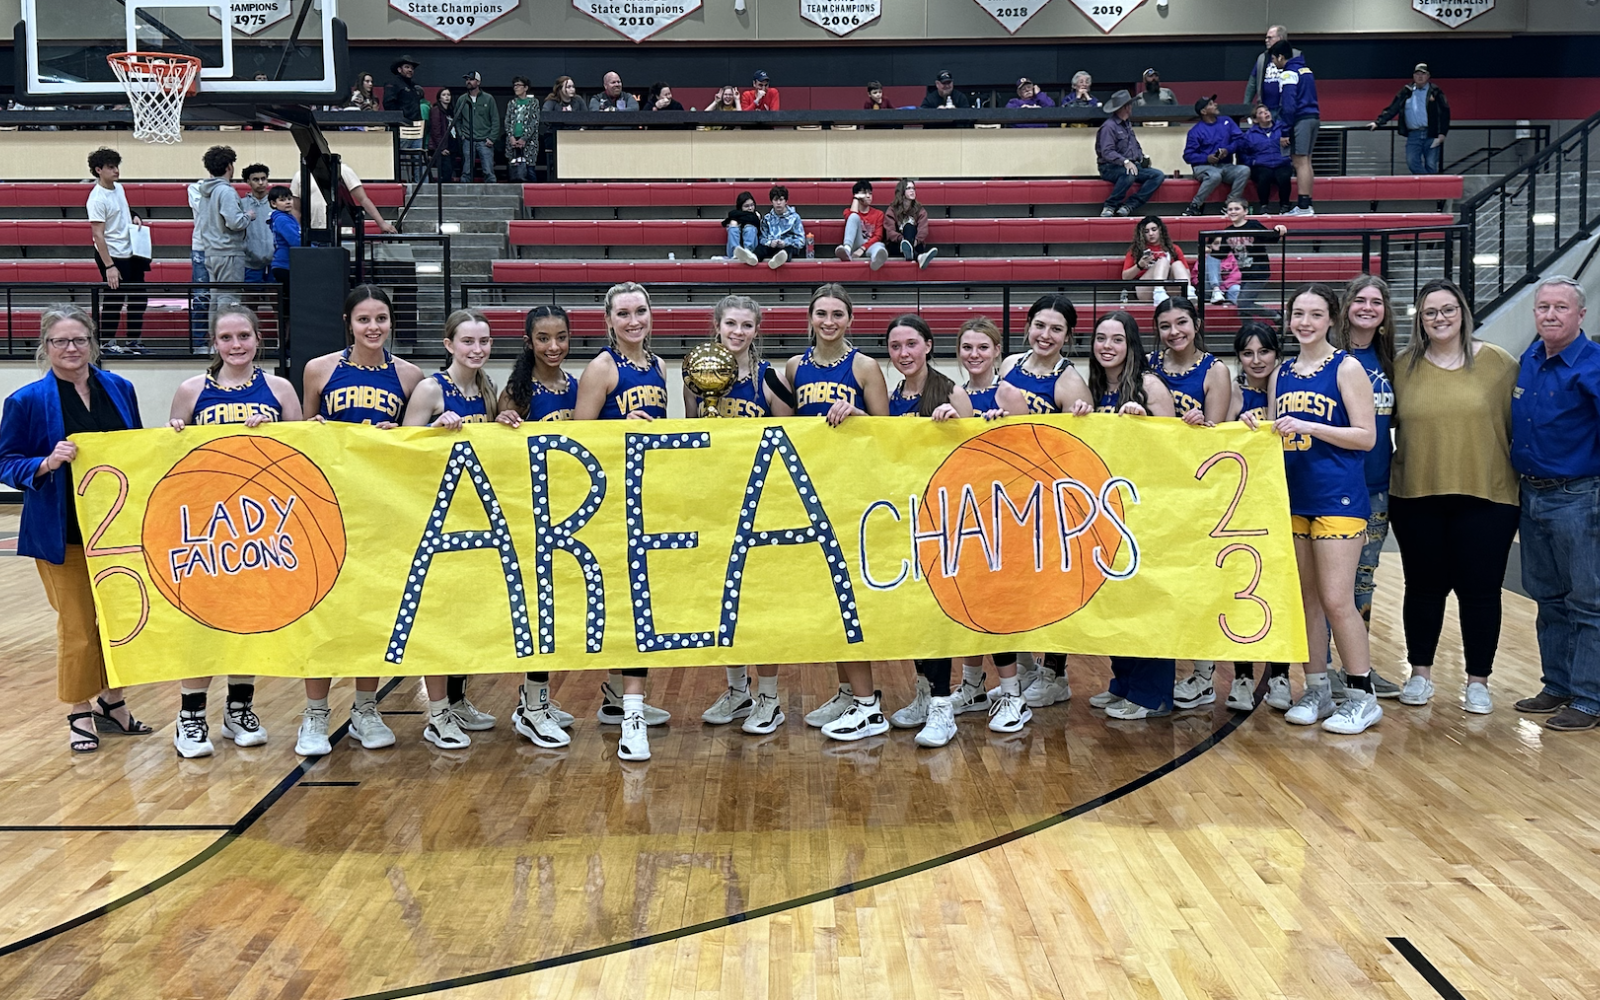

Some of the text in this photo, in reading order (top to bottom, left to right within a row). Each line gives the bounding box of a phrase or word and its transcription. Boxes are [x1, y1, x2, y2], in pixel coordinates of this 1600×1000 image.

[230, 3, 278, 12] HAMPIONS
[408, 2, 503, 15] State Champions
[590, 3, 685, 15] State Champions
[806, 3, 876, 13] TEAM CHAMPIONS
[996, 7, 1028, 17] 2018
[1092, 6, 1123, 16] 2019
[1435, 8, 1473, 18] 2007
[234, 14, 267, 26] 1975
[436, 16, 475, 26] 2009
[618, 16, 655, 26] 2010
[821, 15, 860, 26] 2006
[796, 381, 857, 409] ERIBEST
[325, 385, 404, 421] VERIBEST
[1276, 391, 1337, 421] ERIBEST
[1283, 431, 1313, 451] 23
[179, 494, 297, 544] LADY
[384, 425, 1142, 665] AREA CHAMPS
